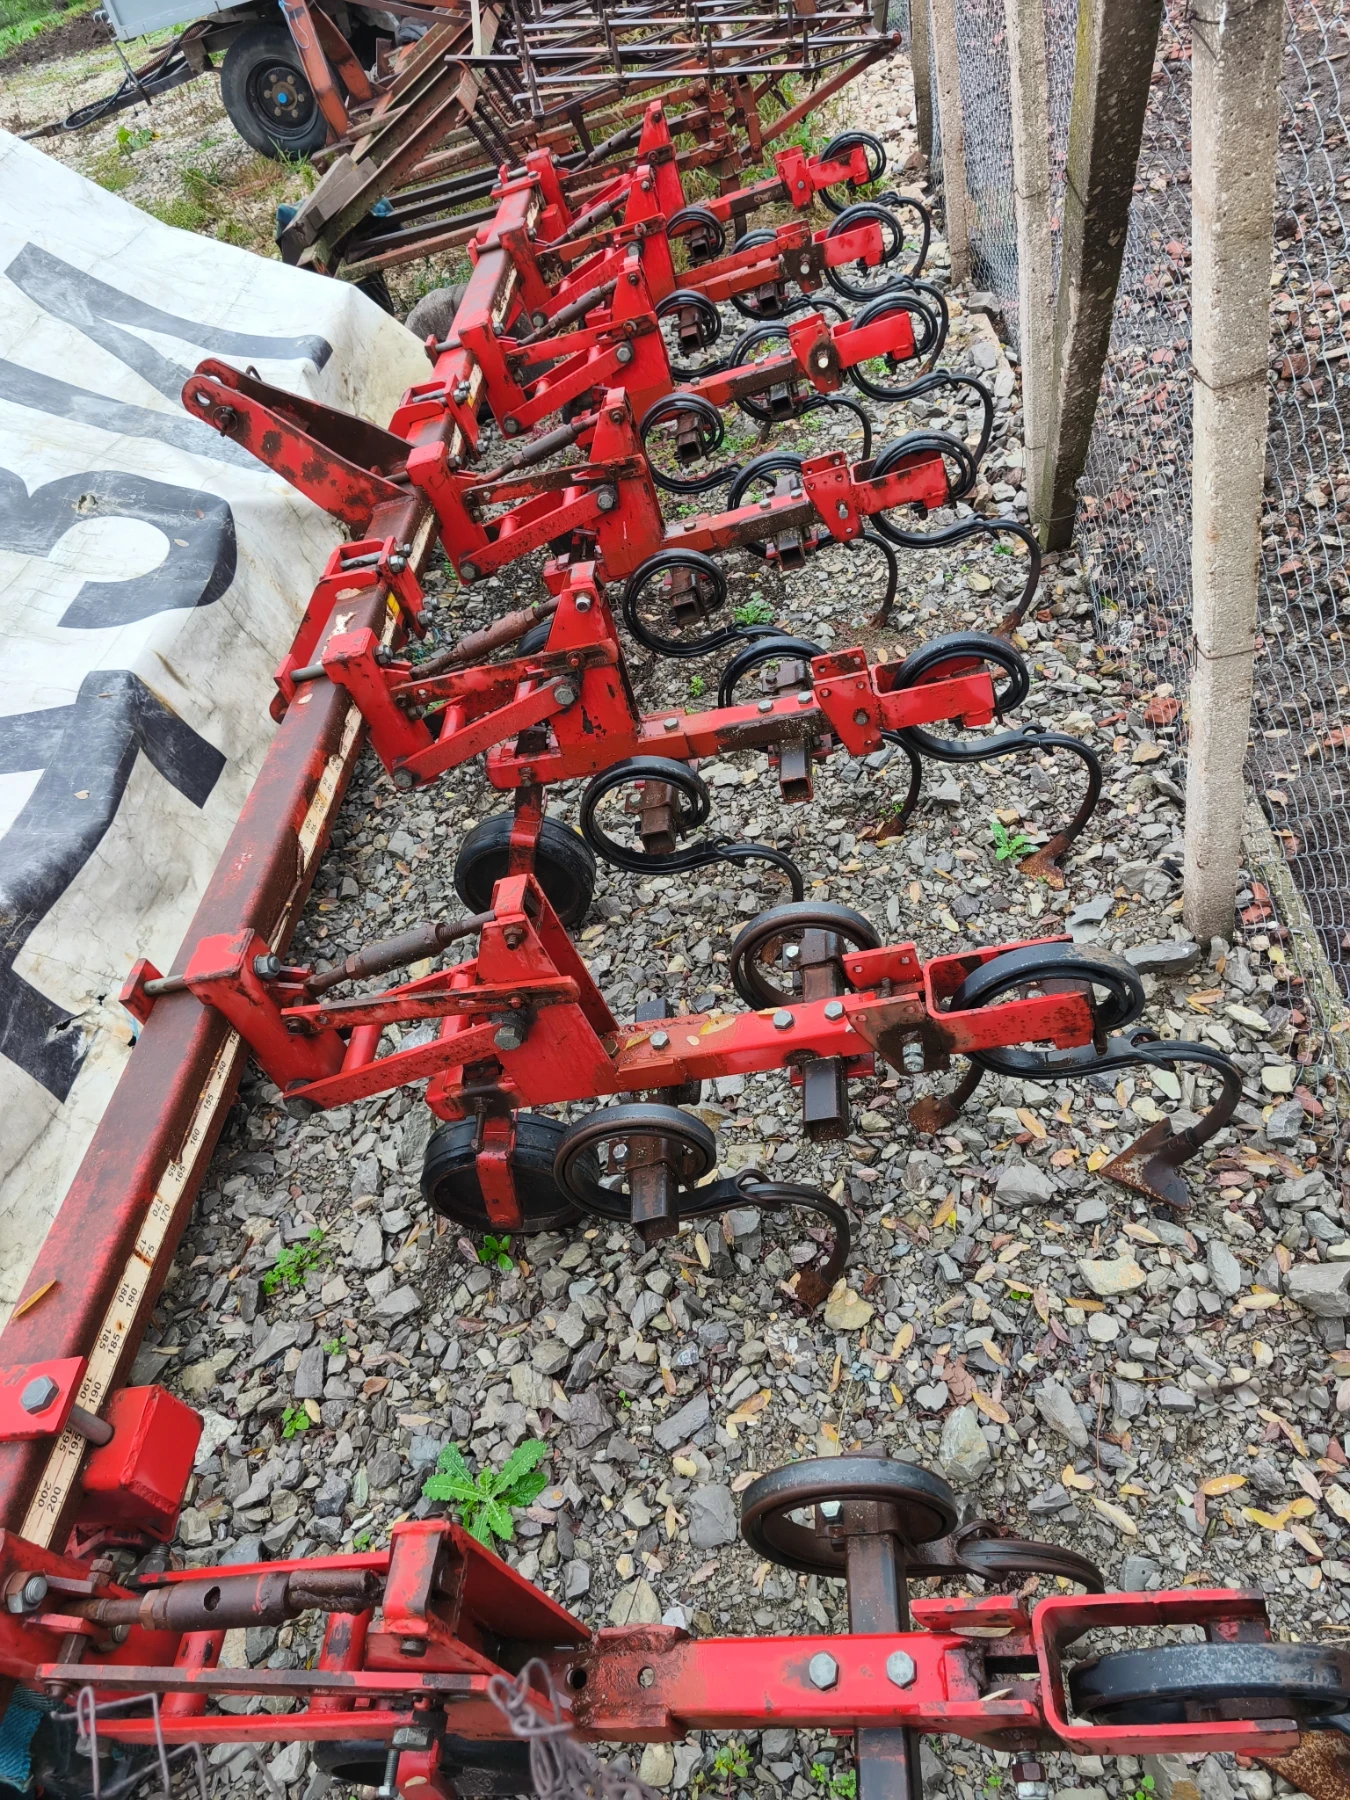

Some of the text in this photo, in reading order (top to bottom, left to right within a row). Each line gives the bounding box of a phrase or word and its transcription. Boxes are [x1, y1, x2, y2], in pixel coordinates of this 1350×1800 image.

[190, 1128, 200, 1146] 160
[203, 1094, 214, 1111] 155
[152, 1198, 163, 1217] 170
[118, 1283, 130, 1304] 180
[46, 1486, 62, 1513] 200
[68, 1432, 82, 1456] 195
[88, 1381, 102, 1404] 190
[107, 1332, 121, 1355] 185
[125, 1287, 138, 1309] 180
[159, 1203, 171, 1223] 170
[175, 1164, 186, 1183] 165
[99, 1328, 112, 1350] 185
[80, 1376, 93, 1399] 190
[59, 1428, 73, 1453] 195
[38, 1482, 52, 1508] 200
